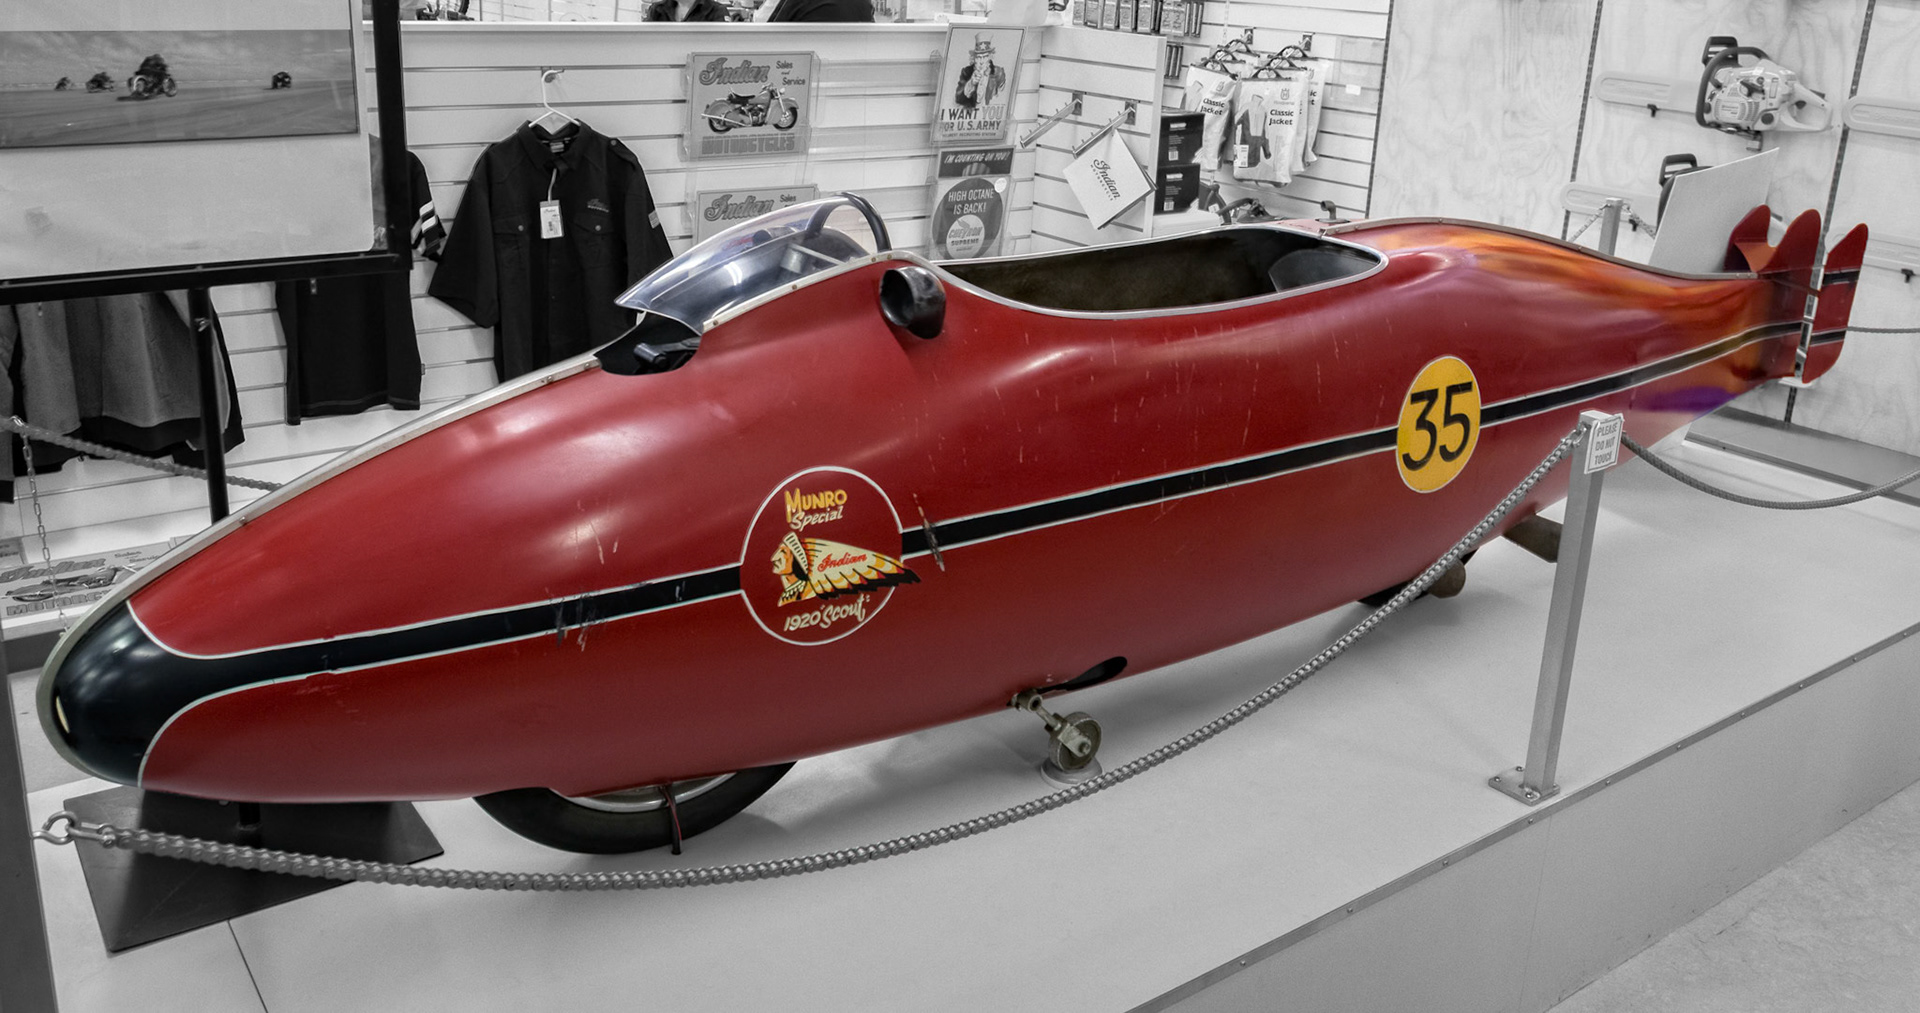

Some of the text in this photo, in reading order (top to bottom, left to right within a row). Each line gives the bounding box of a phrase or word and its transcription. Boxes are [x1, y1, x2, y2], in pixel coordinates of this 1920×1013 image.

[699, 57, 771, 85] Indian
[776, 60, 793, 69] Sales
[782, 77, 806, 86] Service
[1200, 105, 1223, 116] Jacket
[1203, 97, 1225, 109] Classic
[941, 106, 1004, 121] I WANT YOU
[1270, 109, 1294, 117] Classic
[1269, 117, 1293, 126] Jacket
[702, 132, 795, 154] MOTORCYCLES
[955, 153, 985, 163] COUNTING
[985, 153, 995, 162] ON
[1093, 158, 1121, 199] Indian
[780, 194, 797, 203] Sales
[948, 188, 994, 202] HIGH OCTANE
[704, 194, 774, 221] Indian
[953, 202, 987, 215] IS BACK!
[951, 238, 979, 246] SUPREME
[1402, 381, 1473, 471] 35
[1597, 422, 1618, 437] PLEASE
[1595, 436, 1615, 451] DO NOT
[1595, 450, 1612, 465] TOUCH
[790, 505, 844, 532] Special
[817, 552, 867, 572] Indian
[783, 611, 821, 632] 1920
